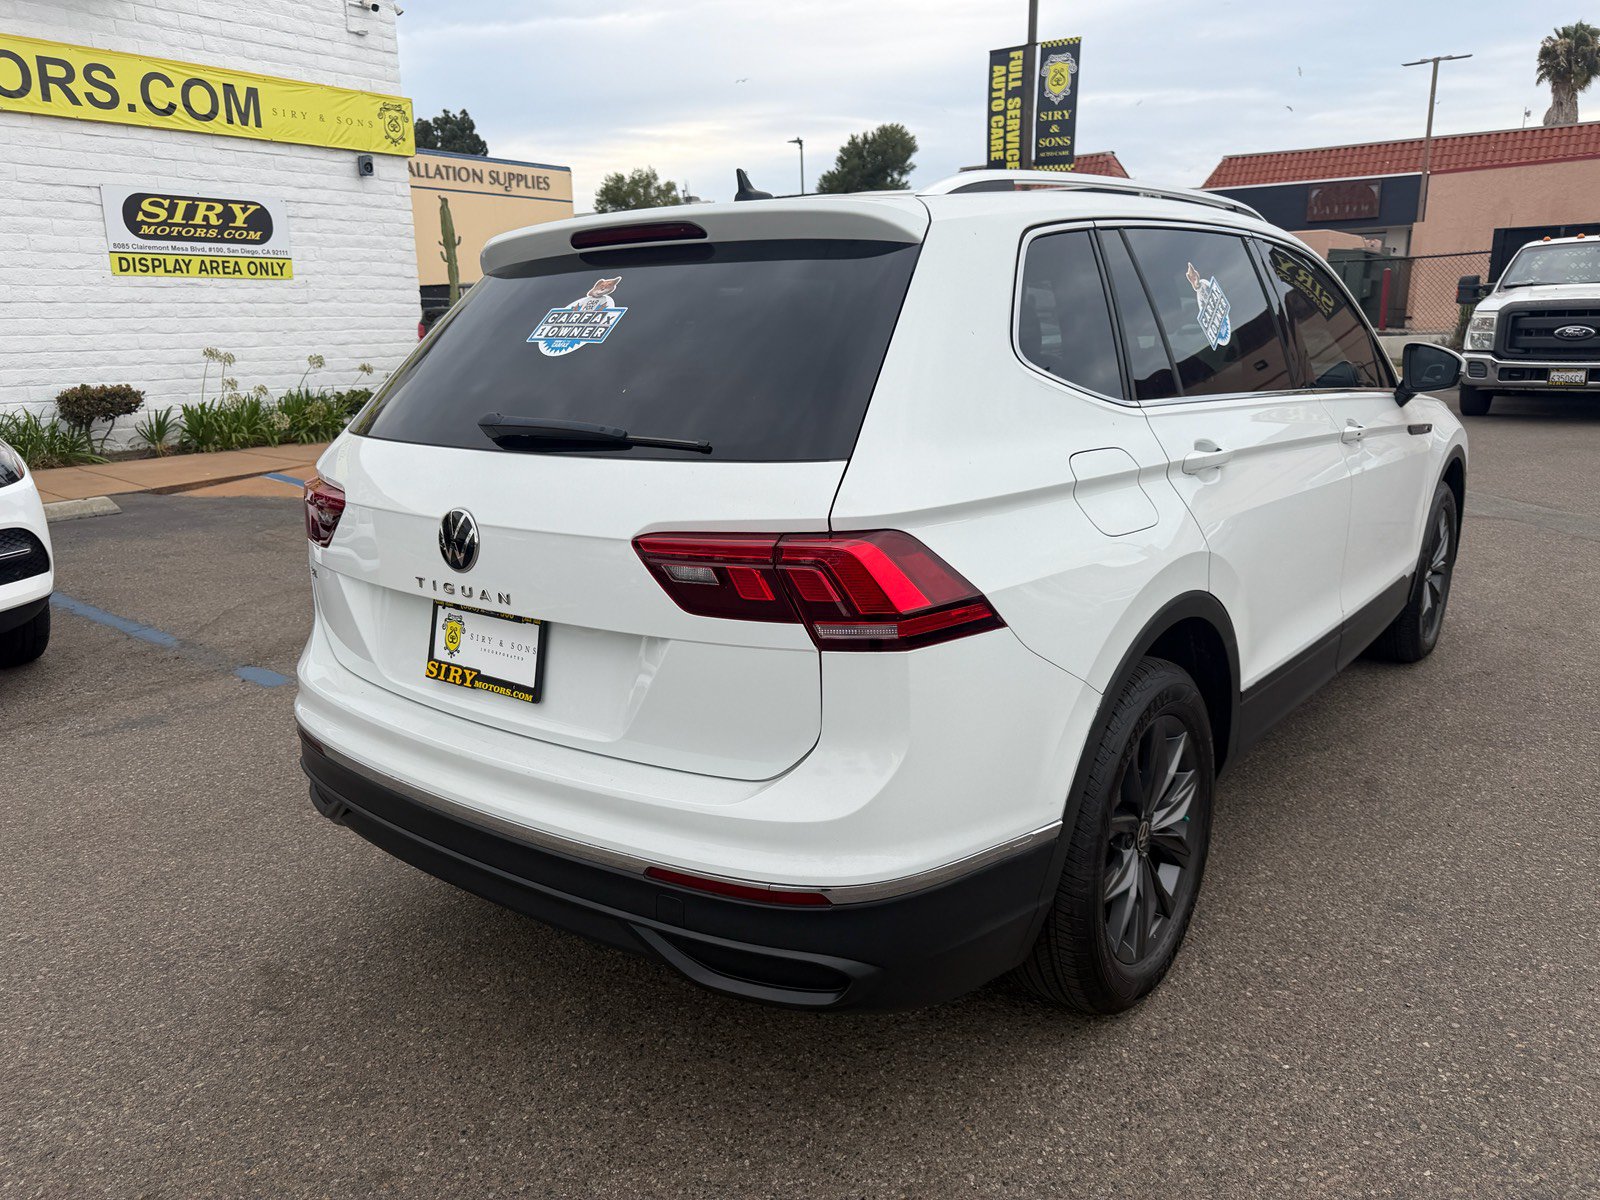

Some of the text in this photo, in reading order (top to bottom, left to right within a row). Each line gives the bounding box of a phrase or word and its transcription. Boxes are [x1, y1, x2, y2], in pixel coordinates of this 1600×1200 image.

[0, 48, 375, 129] ORS.COM SIRY & SONS
[990, 65, 1006, 161] AUTO CARE
[1006, 50, 1023, 170] FULL SERVICE
[1039, 110, 1072, 121] SIRY
[1049, 124, 1060, 133] &
[1038, 136, 1072, 148] SONS
[489, 170, 550, 191] SUPPLIES
[136, 197, 261, 229] SIRY
[139, 225, 264, 241] MOTORS.COM
[112, 242, 130, 250] 8085
[131, 243, 170, 252] Clairemont
[118, 256, 287, 277] DISPLAY AREA ONLY
[547, 313, 615, 325] CARFAX
[547, 326, 606, 338] OWNER
[415, 576, 513, 606] TIGUAN
[469, 632, 538, 656] SIRY & SONS
[425, 660, 534, 703] SIRY MOTORS.COM
